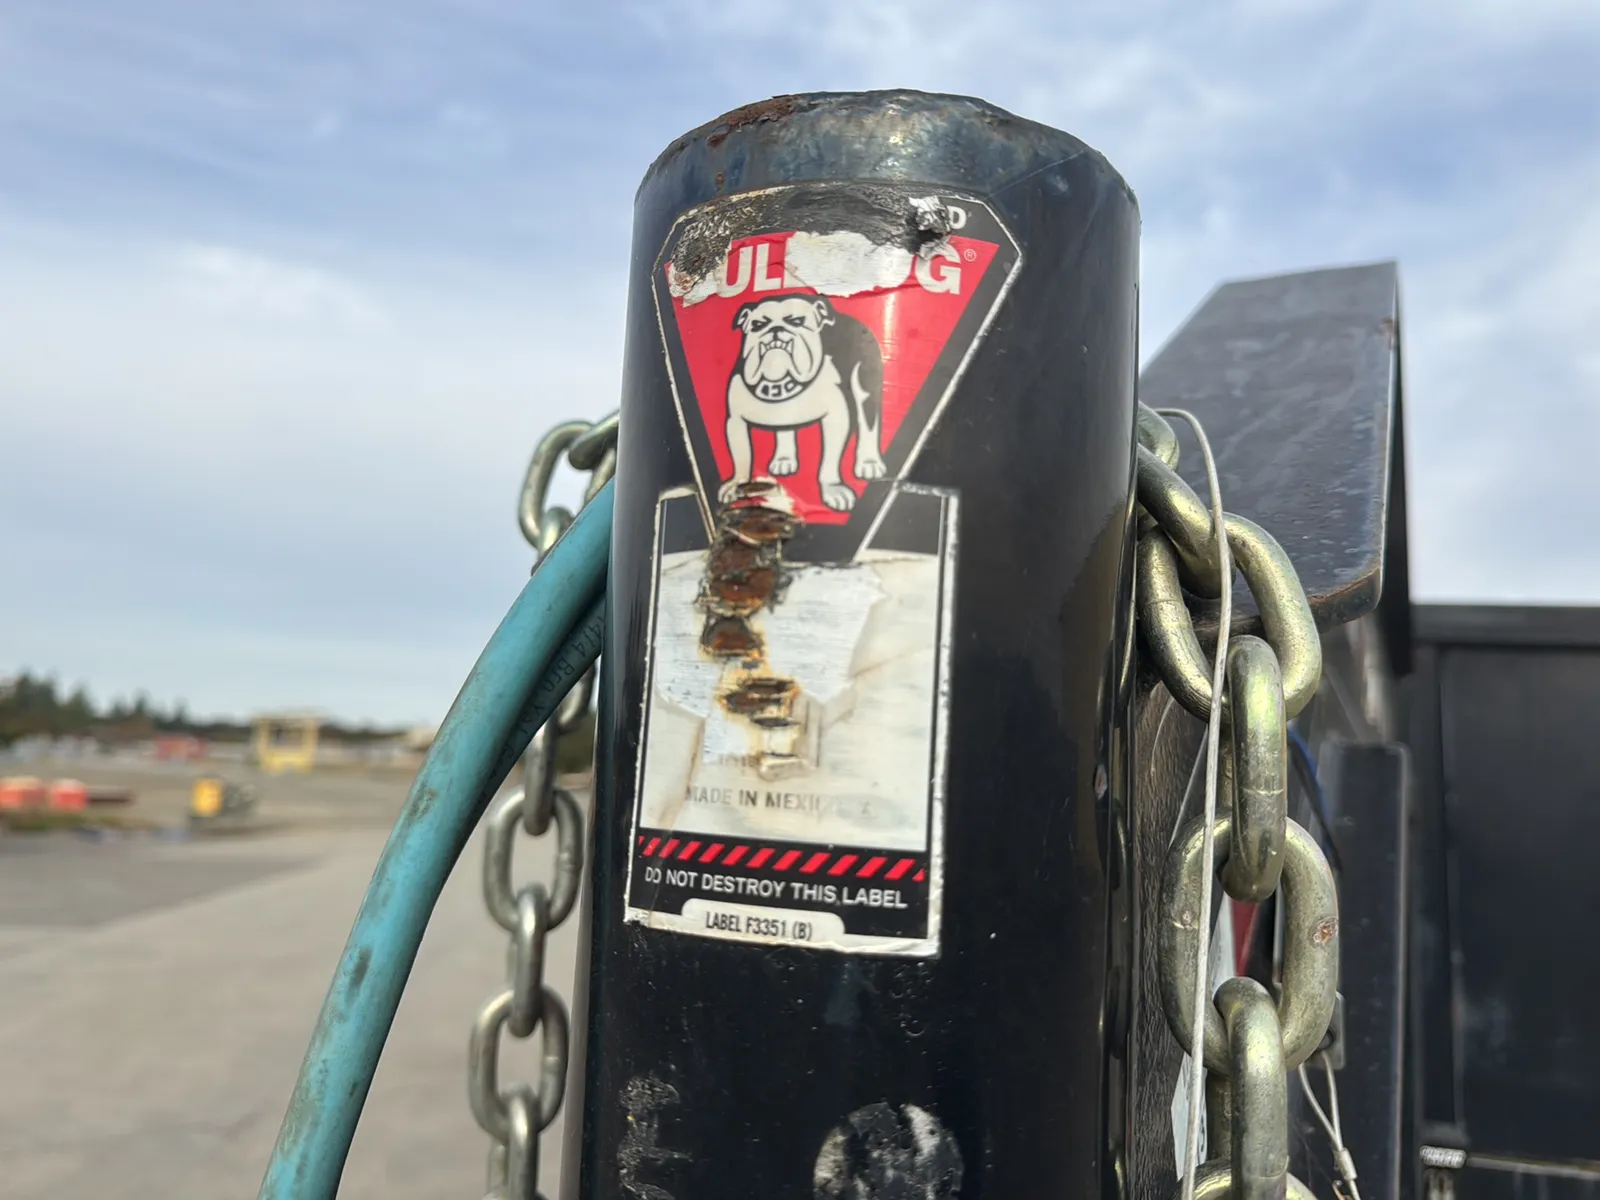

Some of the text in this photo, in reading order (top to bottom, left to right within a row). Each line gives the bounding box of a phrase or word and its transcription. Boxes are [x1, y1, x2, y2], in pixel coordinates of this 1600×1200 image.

[685, 786, 732, 805] MADE
[739, 789, 758, 807] IN
[644, 866, 908, 909] DO NOT DESTROY THIS LABEL
[705, 911, 812, 941] LABEL F3351 (B)
